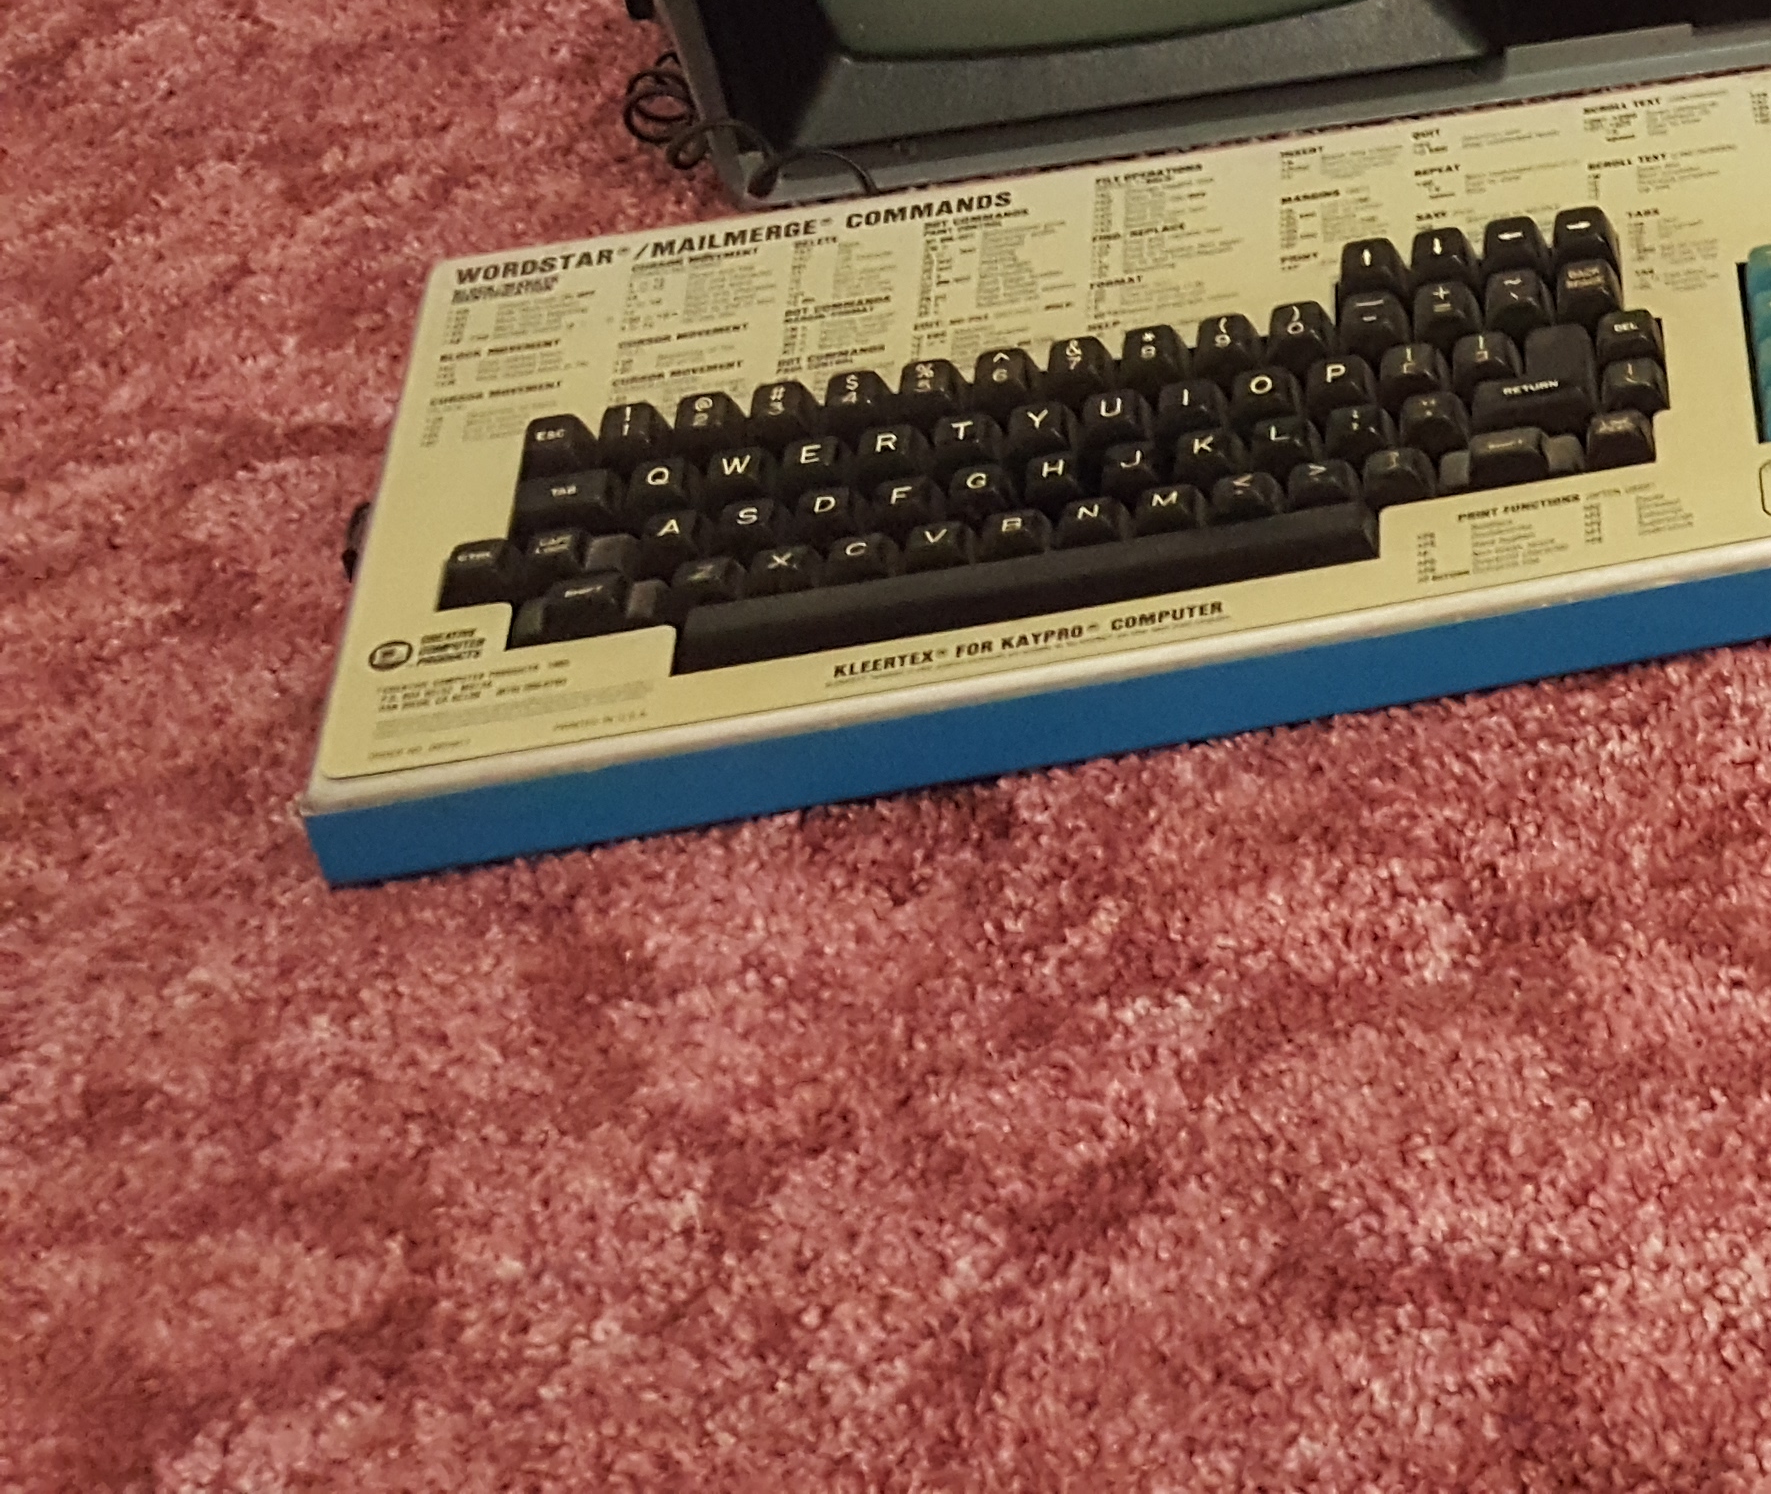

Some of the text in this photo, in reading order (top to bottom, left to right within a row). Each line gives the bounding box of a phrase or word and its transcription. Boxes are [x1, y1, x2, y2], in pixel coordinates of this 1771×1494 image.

[845, 191, 1012, 230] COMMANDS
[1215, 334, 1231, 346] 9
[993, 369, 1007, 381] 6
[1327, 364, 1345, 382] P
[1250, 376, 1272, 393] O
[1503, 381, 1558, 395] RETURN
[1101, 398, 1121, 416] U
[693, 413, 708, 426] 2
[1028, 410, 1048, 428] Y
[952, 421, 973, 439] T
[1270, 426, 1290, 440] L
[876, 434, 897, 452] R
[1194, 436, 1213, 453] K
[800, 445, 820, 463] E
[1121, 451, 1141, 468] J
[723, 455, 750, 474] W
[1042, 459, 1063, 477] H
[647, 468, 669, 485] Q
[967, 473, 986, 488] G
[891, 486, 912, 504] F
[1152, 491, 1177, 506] M
[814, 497, 835, 512] D
[1078, 504, 1098, 519] N
[737, 508, 757, 524] S
[658, 519, 679, 536] A
[1002, 518, 1021, 532] B
[925, 529, 947, 543] V
[846, 542, 866, 555] C
[768, 553, 791, 568] X
[955, 640, 994, 658] FOR
[1110, 600, 1224, 632] COMPUTER
